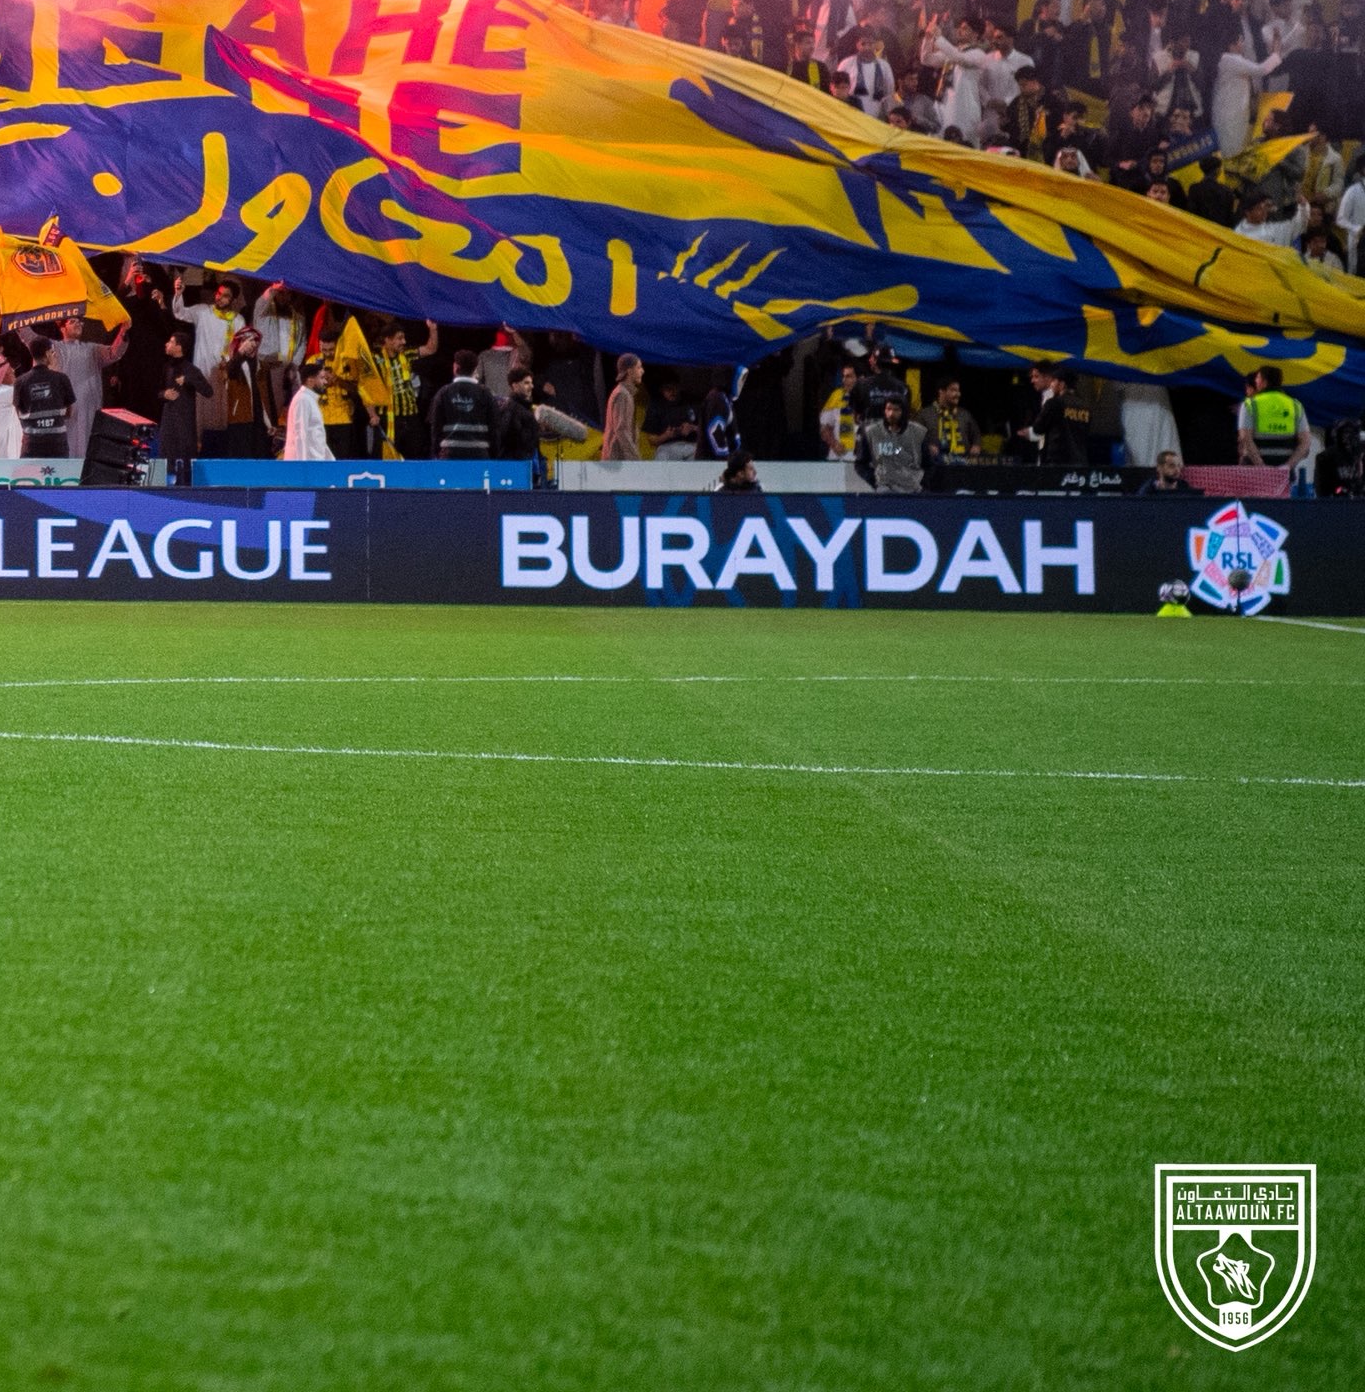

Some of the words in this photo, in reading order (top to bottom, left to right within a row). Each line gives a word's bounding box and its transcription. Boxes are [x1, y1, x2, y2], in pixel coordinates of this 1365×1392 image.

[1090, 472, 1122, 487] شماغ
[501, 514, 1095, 596] BURAYDAH
[1221, 552, 1258, 572] RSL
